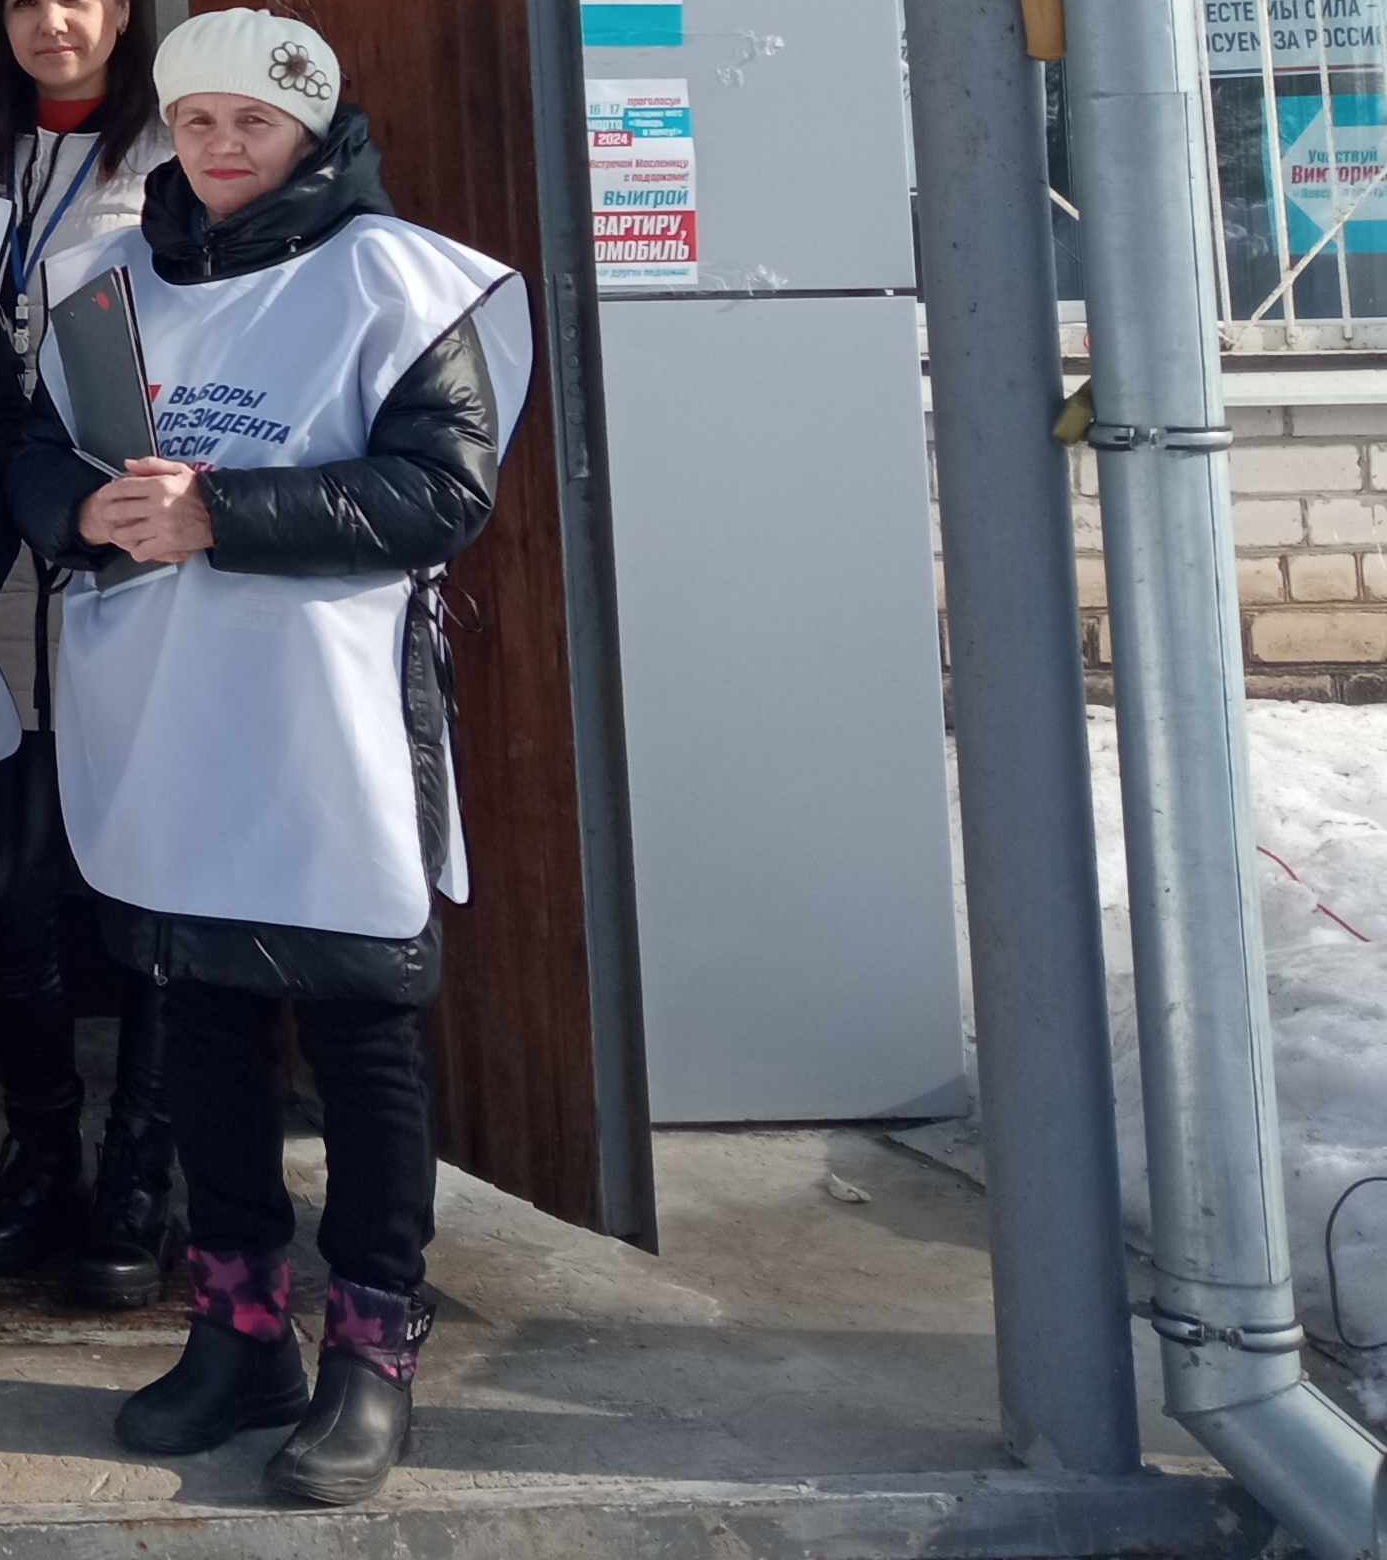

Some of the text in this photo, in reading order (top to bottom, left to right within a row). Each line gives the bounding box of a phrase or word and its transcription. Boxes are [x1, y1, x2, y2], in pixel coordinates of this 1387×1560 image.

[1206, 1, 1255, 23] ЕСТЕ
[1273, 30, 1300, 51] ЗА
[589, 104, 621, 115] 16 17
[598, 132, 629, 145] 2024
[1308, 146, 1377, 165] Учствуй
[603, 185, 689, 208] выиграй
[594, 214, 688, 241] ВАРТИРУ,
[594, 240, 690, 262] ОМОБИЛЬ
[160, 435, 220, 457] ОССИИ
